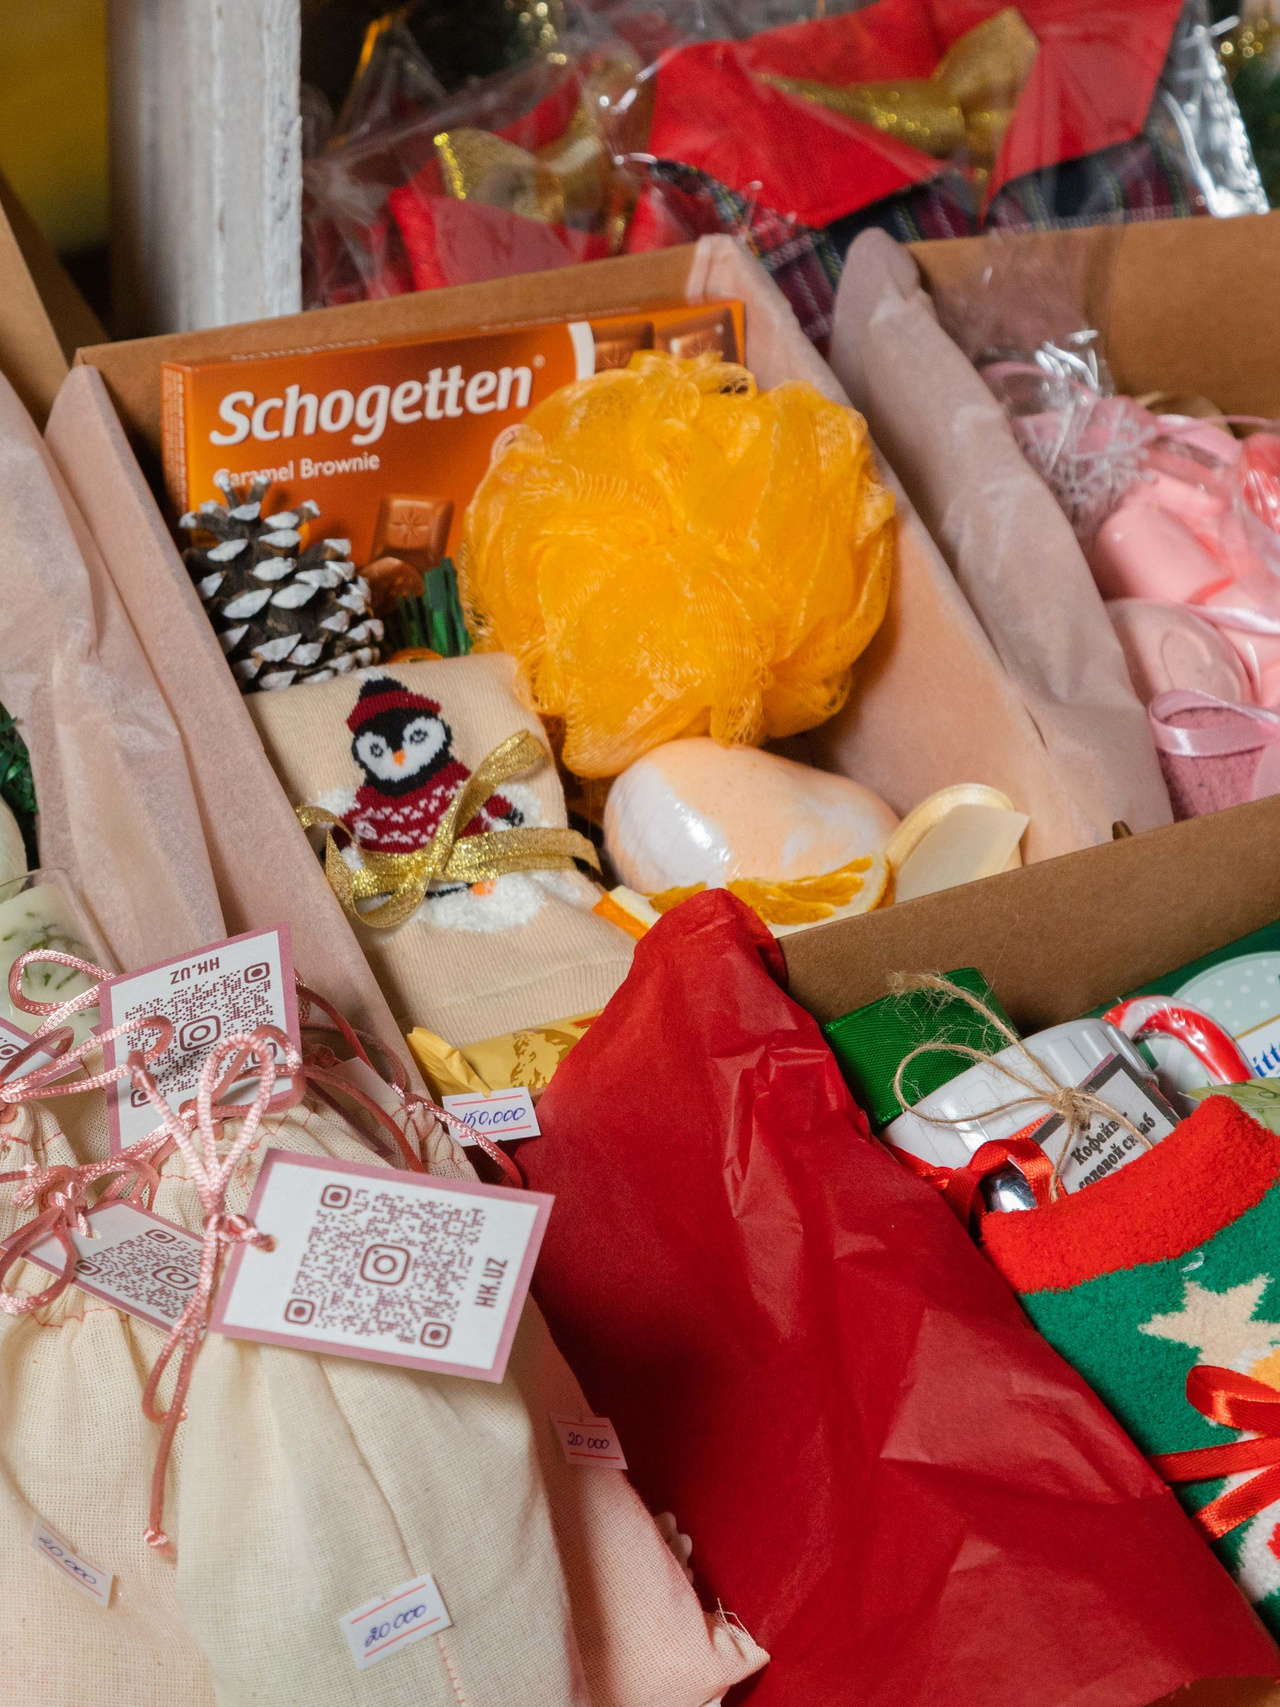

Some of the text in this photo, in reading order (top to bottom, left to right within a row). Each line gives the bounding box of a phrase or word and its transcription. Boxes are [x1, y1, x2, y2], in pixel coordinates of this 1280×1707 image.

[209, 364, 532, 446] Schogetten
[299, 452, 380, 479] Brownie
[169, 957, 220, 986] HK.UZ
[1122, 1112, 1156, 1151] скаб
[475, 1257, 508, 1308] HK.UZ
